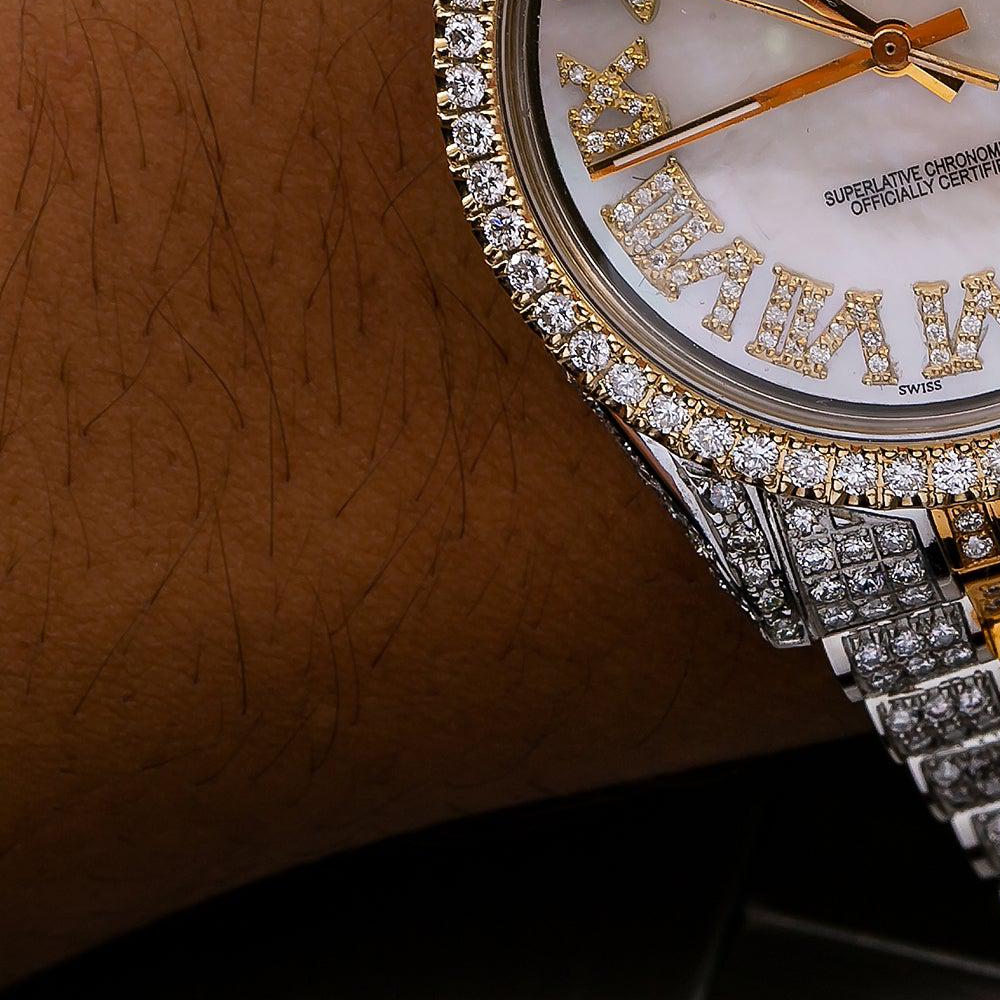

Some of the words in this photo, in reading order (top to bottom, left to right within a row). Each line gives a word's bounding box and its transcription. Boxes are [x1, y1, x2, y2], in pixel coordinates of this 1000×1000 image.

[824, 164, 922, 207] SUPERLATIVE
[850, 178, 935, 216] OFFICIALLY
[745, 264, 900, 386] VII
[898, 380, 943, 396] SWISS
